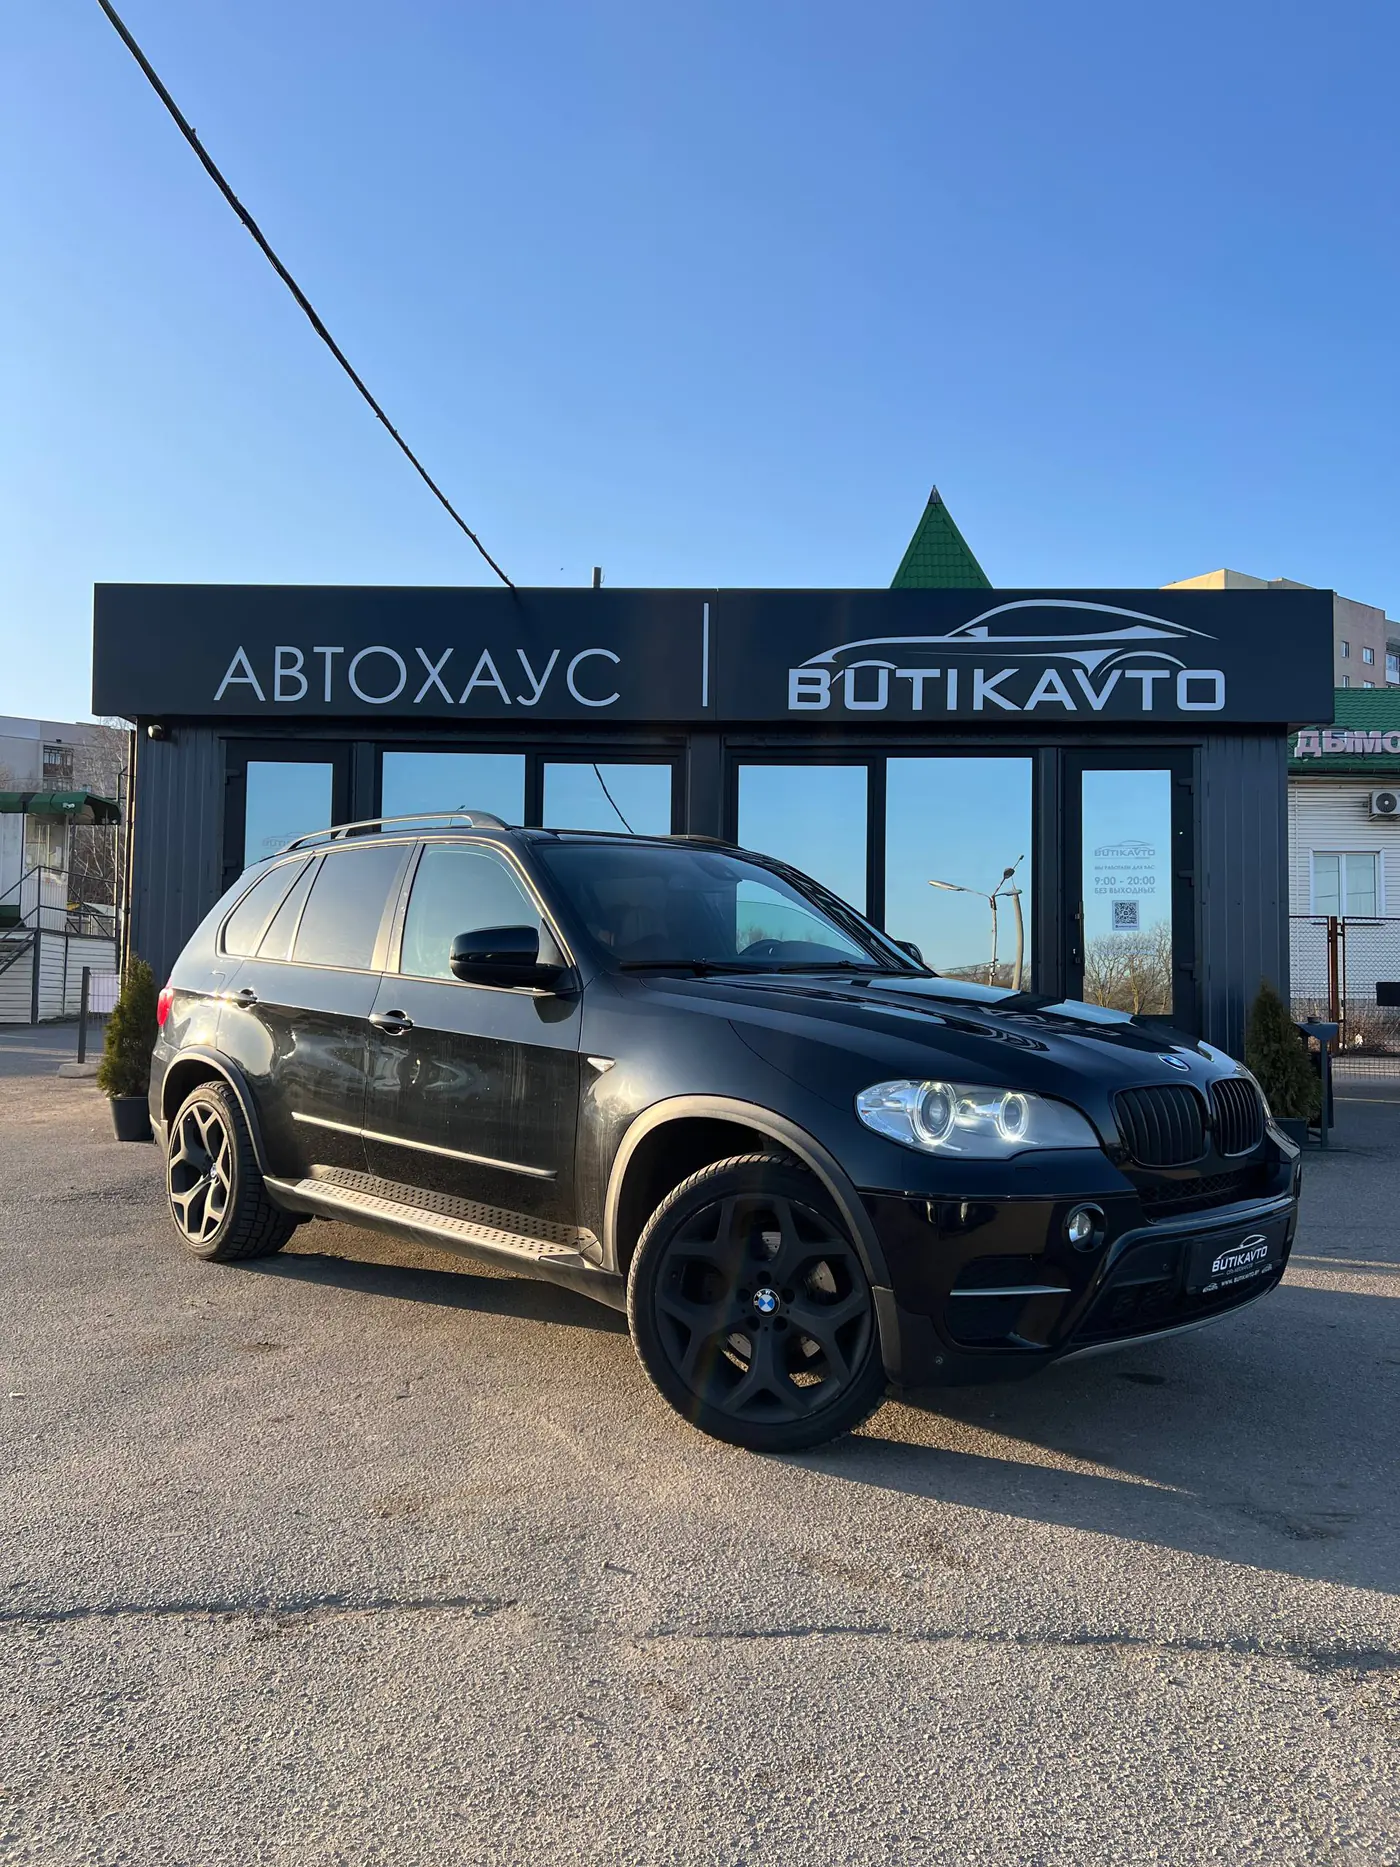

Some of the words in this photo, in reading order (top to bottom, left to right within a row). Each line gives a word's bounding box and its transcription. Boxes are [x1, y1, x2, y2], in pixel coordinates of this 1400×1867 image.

[213, 645, 622, 708] АВТОХАУС
[788, 668, 1226, 711] BUTIKAVTO
[1094, 849, 1156, 857] BUTIKAVTO
[1094, 876, 1116, 885] 9:00
[1127, 876, 1156, 885] 20:00
[1211, 1246, 1268, 1272] BUTIKAVTO
